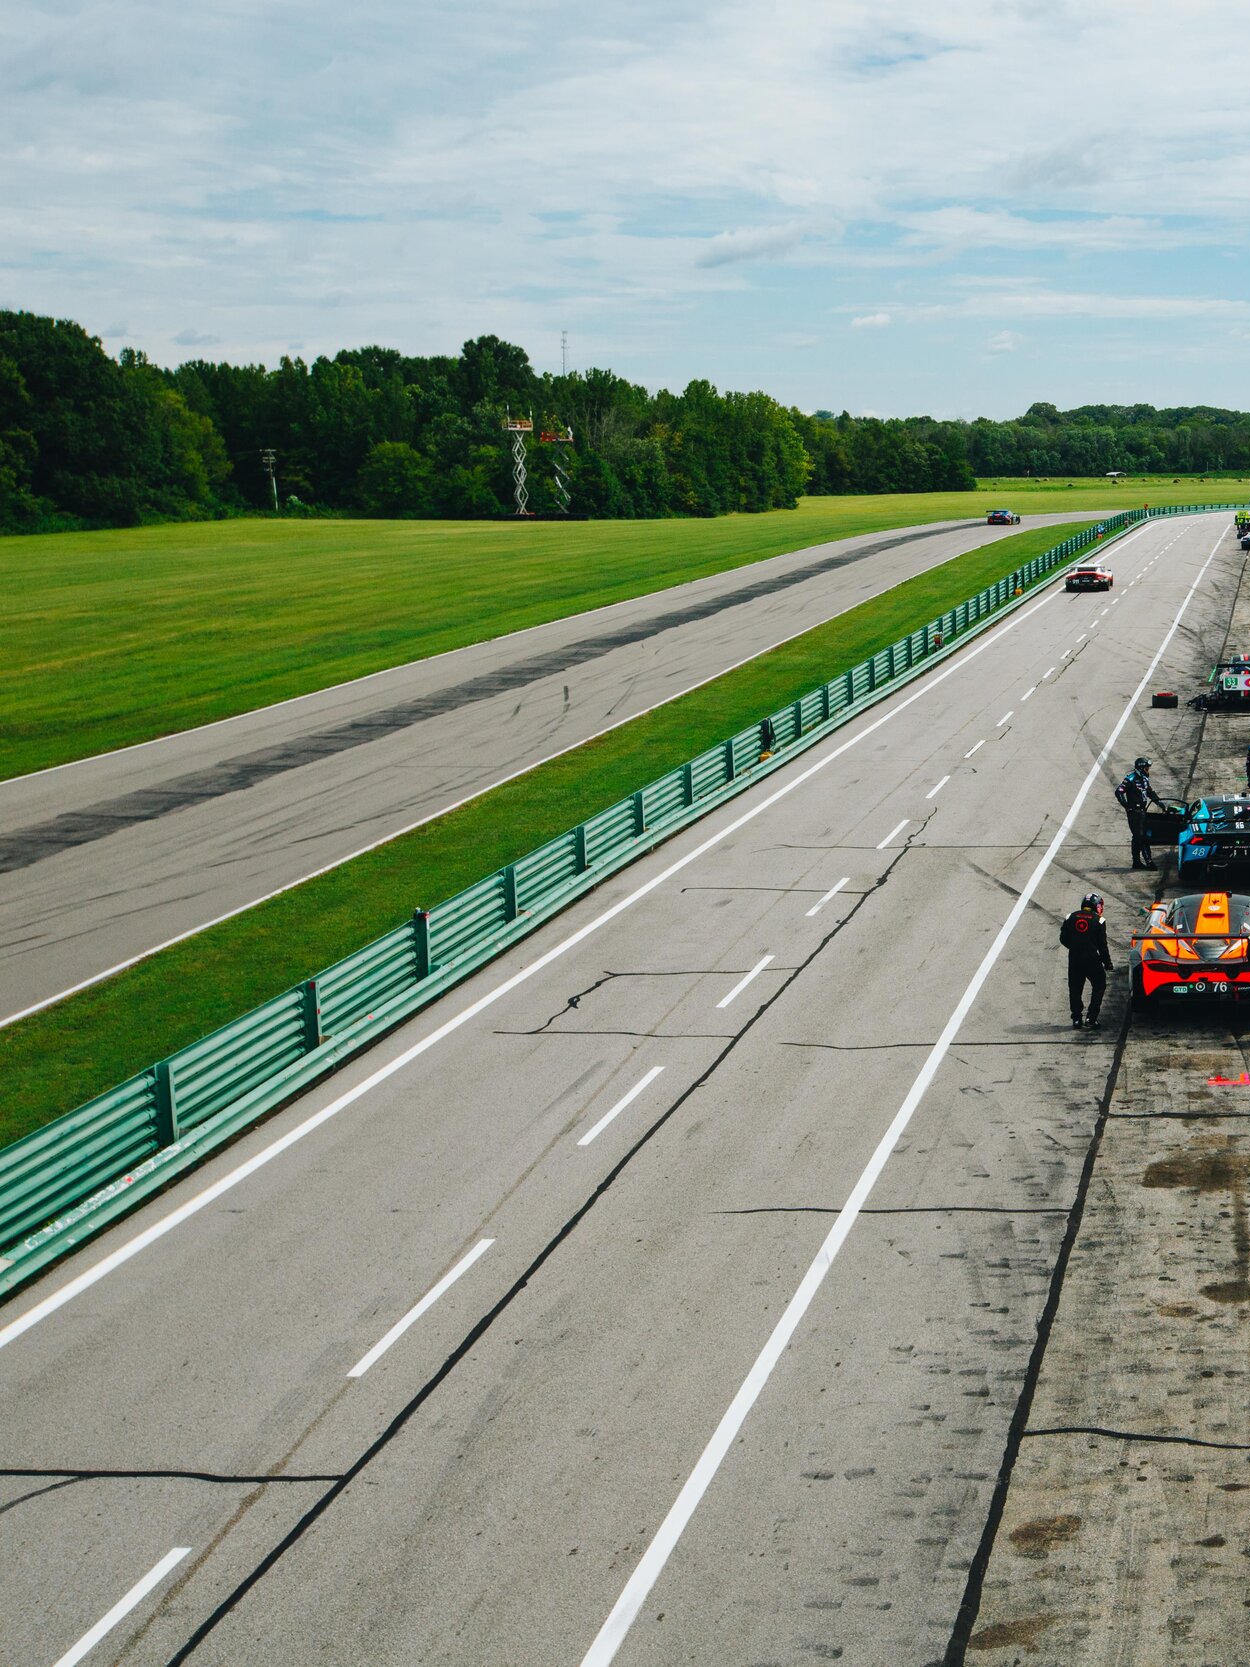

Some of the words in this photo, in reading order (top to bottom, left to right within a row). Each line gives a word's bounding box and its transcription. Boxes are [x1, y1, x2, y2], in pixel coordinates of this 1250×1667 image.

[1227, 678, 1236, 686] 33
[1192, 847, 1205, 857] 48
[1212, 981, 1227, 993] 76
